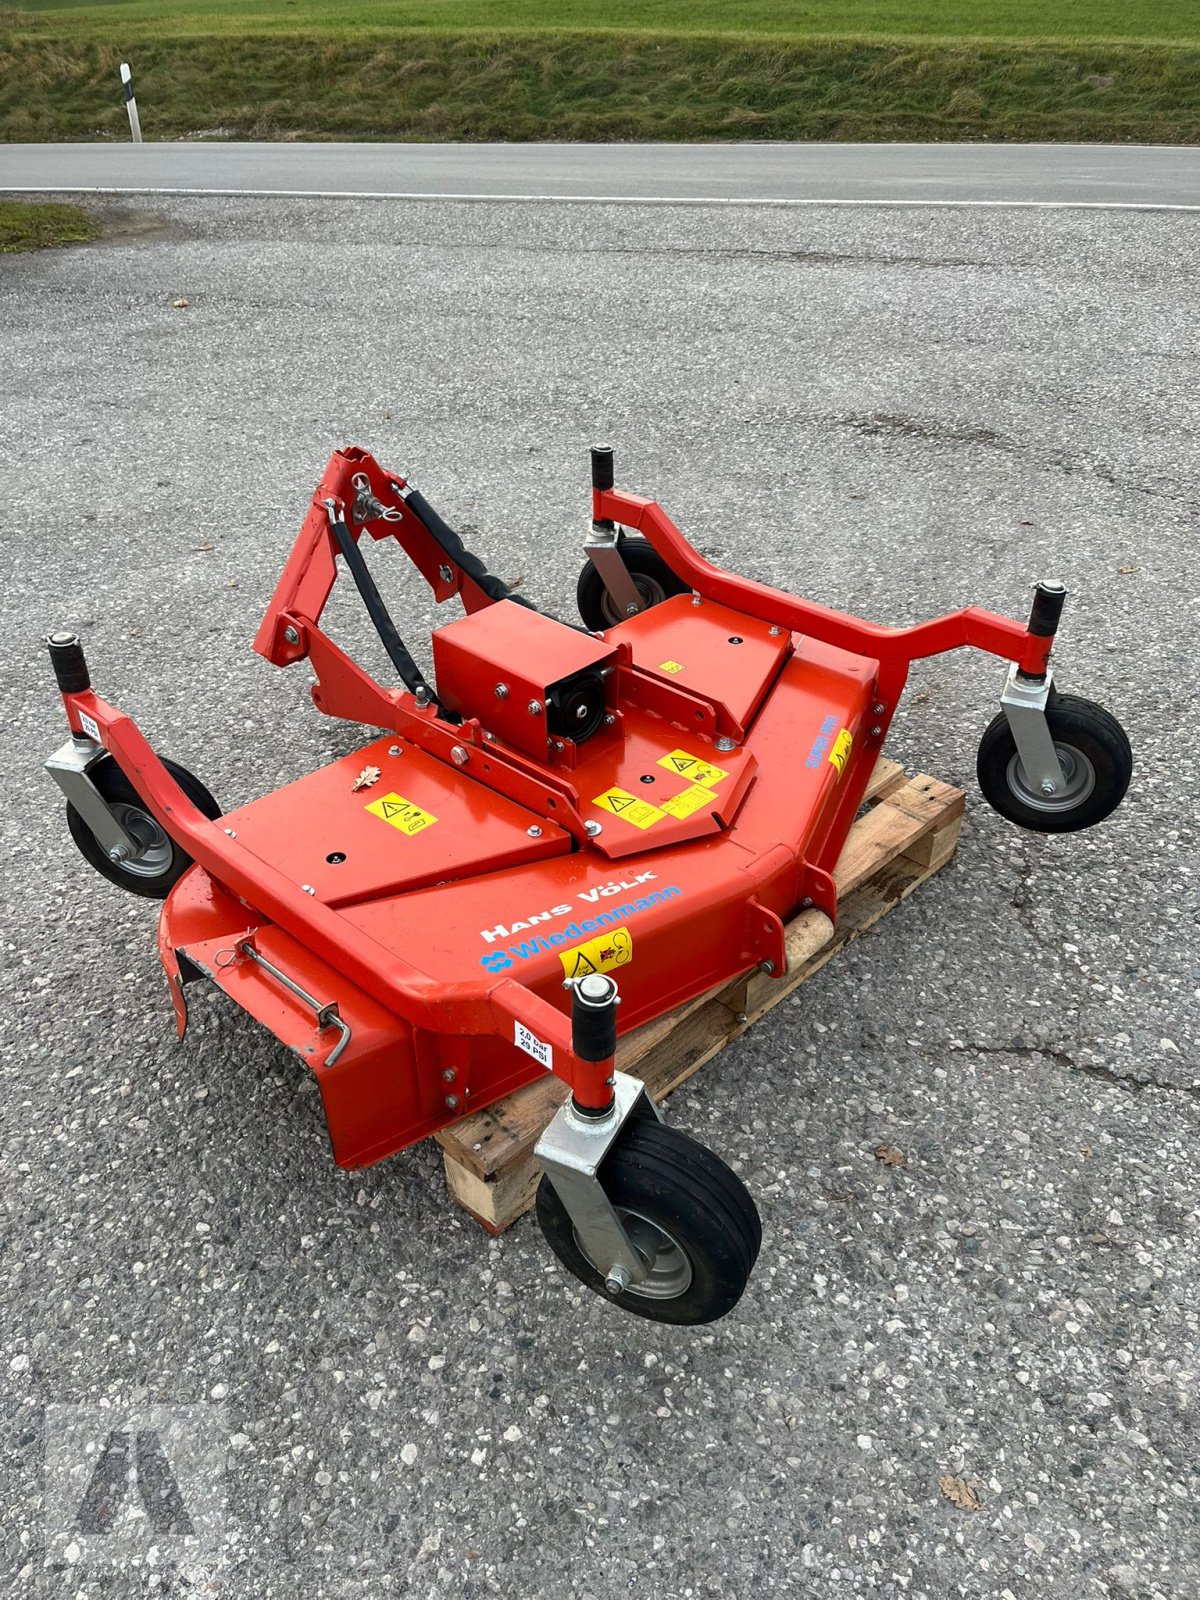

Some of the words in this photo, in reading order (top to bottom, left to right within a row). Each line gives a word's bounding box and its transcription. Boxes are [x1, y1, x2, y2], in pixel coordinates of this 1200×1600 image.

[480, 903, 573, 943] HANS
[576, 870, 658, 903] VÖLK
[508, 885, 683, 960] Wiedenmann
[520, 1038, 531, 1050] 29
[532, 1046, 547, 1062] PSI
[533, 1038, 548, 1052] bar
